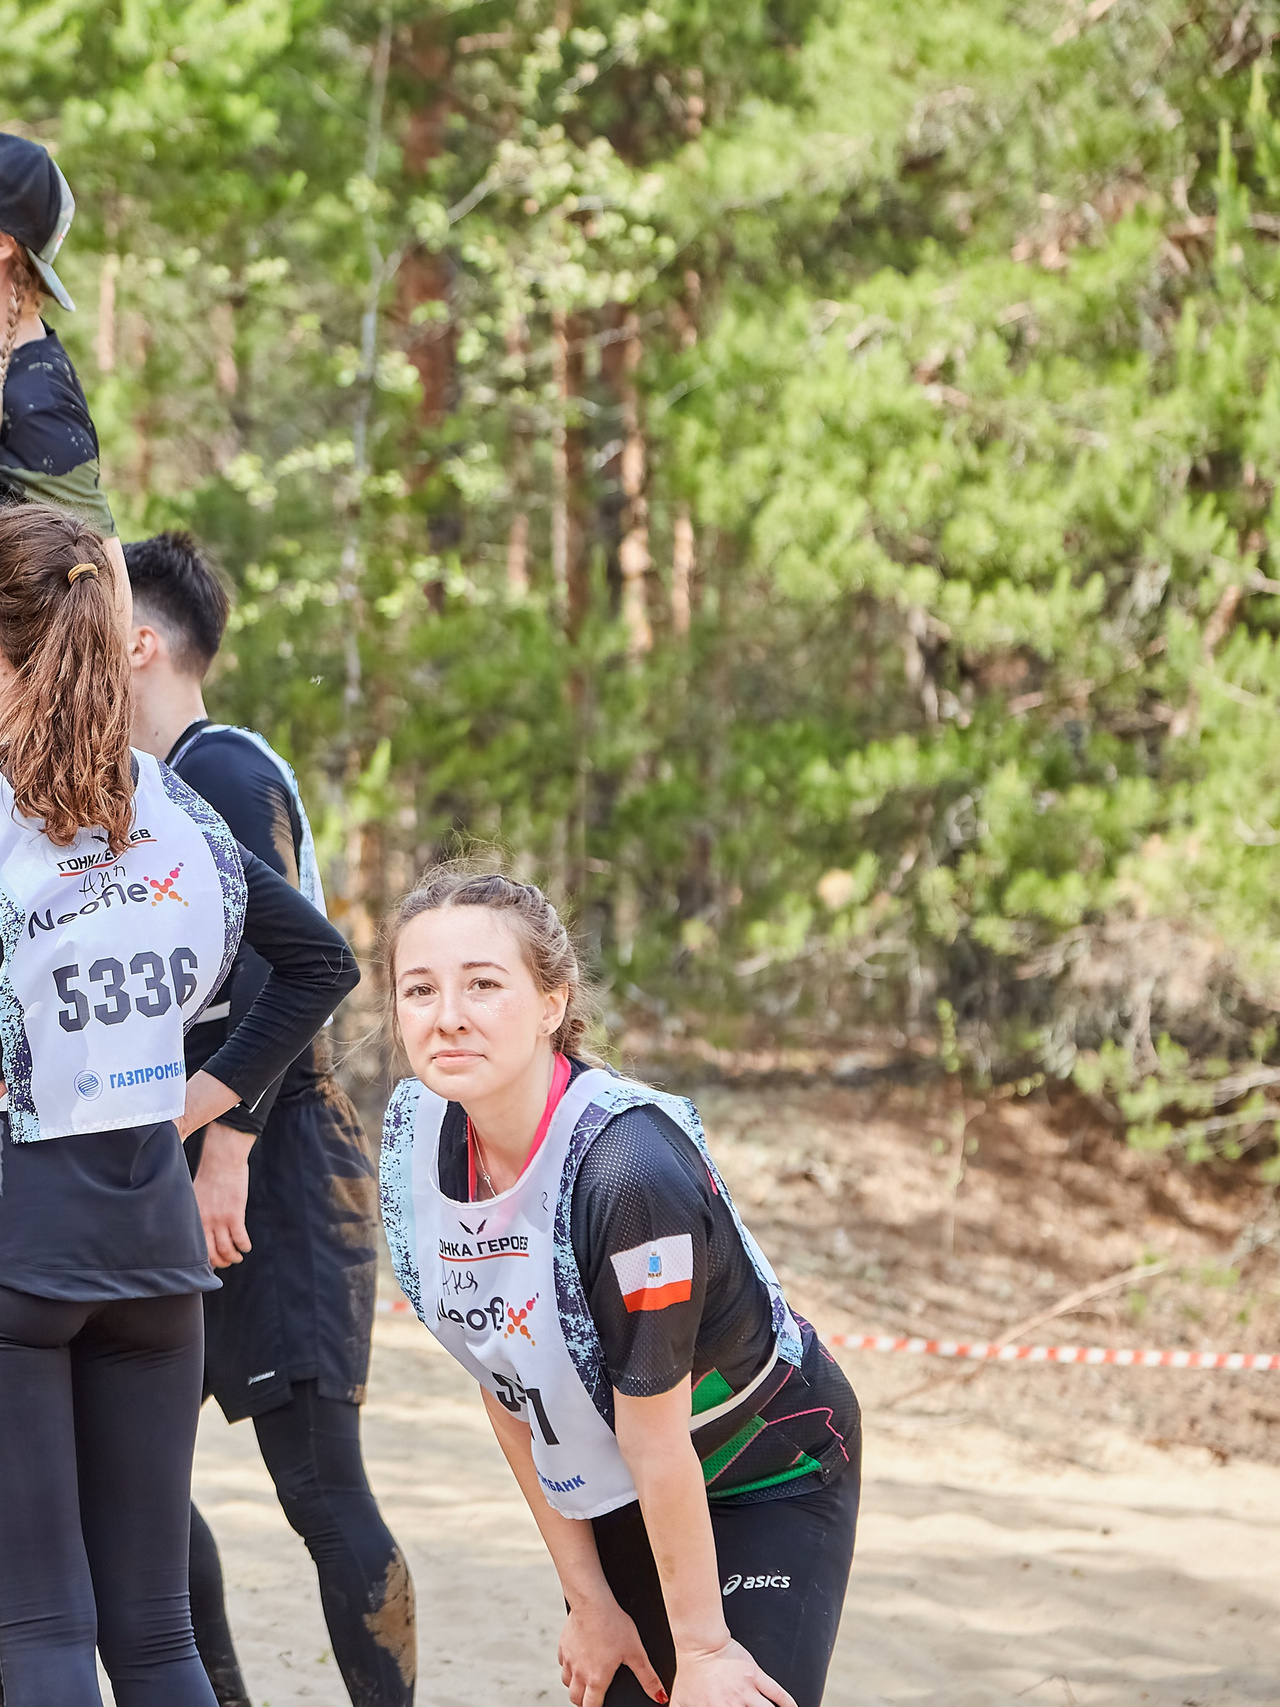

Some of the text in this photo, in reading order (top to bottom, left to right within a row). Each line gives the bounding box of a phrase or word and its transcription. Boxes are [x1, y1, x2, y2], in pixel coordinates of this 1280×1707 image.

[28, 861, 190, 940] Neoflex
[52, 946, 199, 1033] 5336
[476, 1236, 528, 1255] ГЕРОЕВ
[742, 1574, 791, 1589] asics
